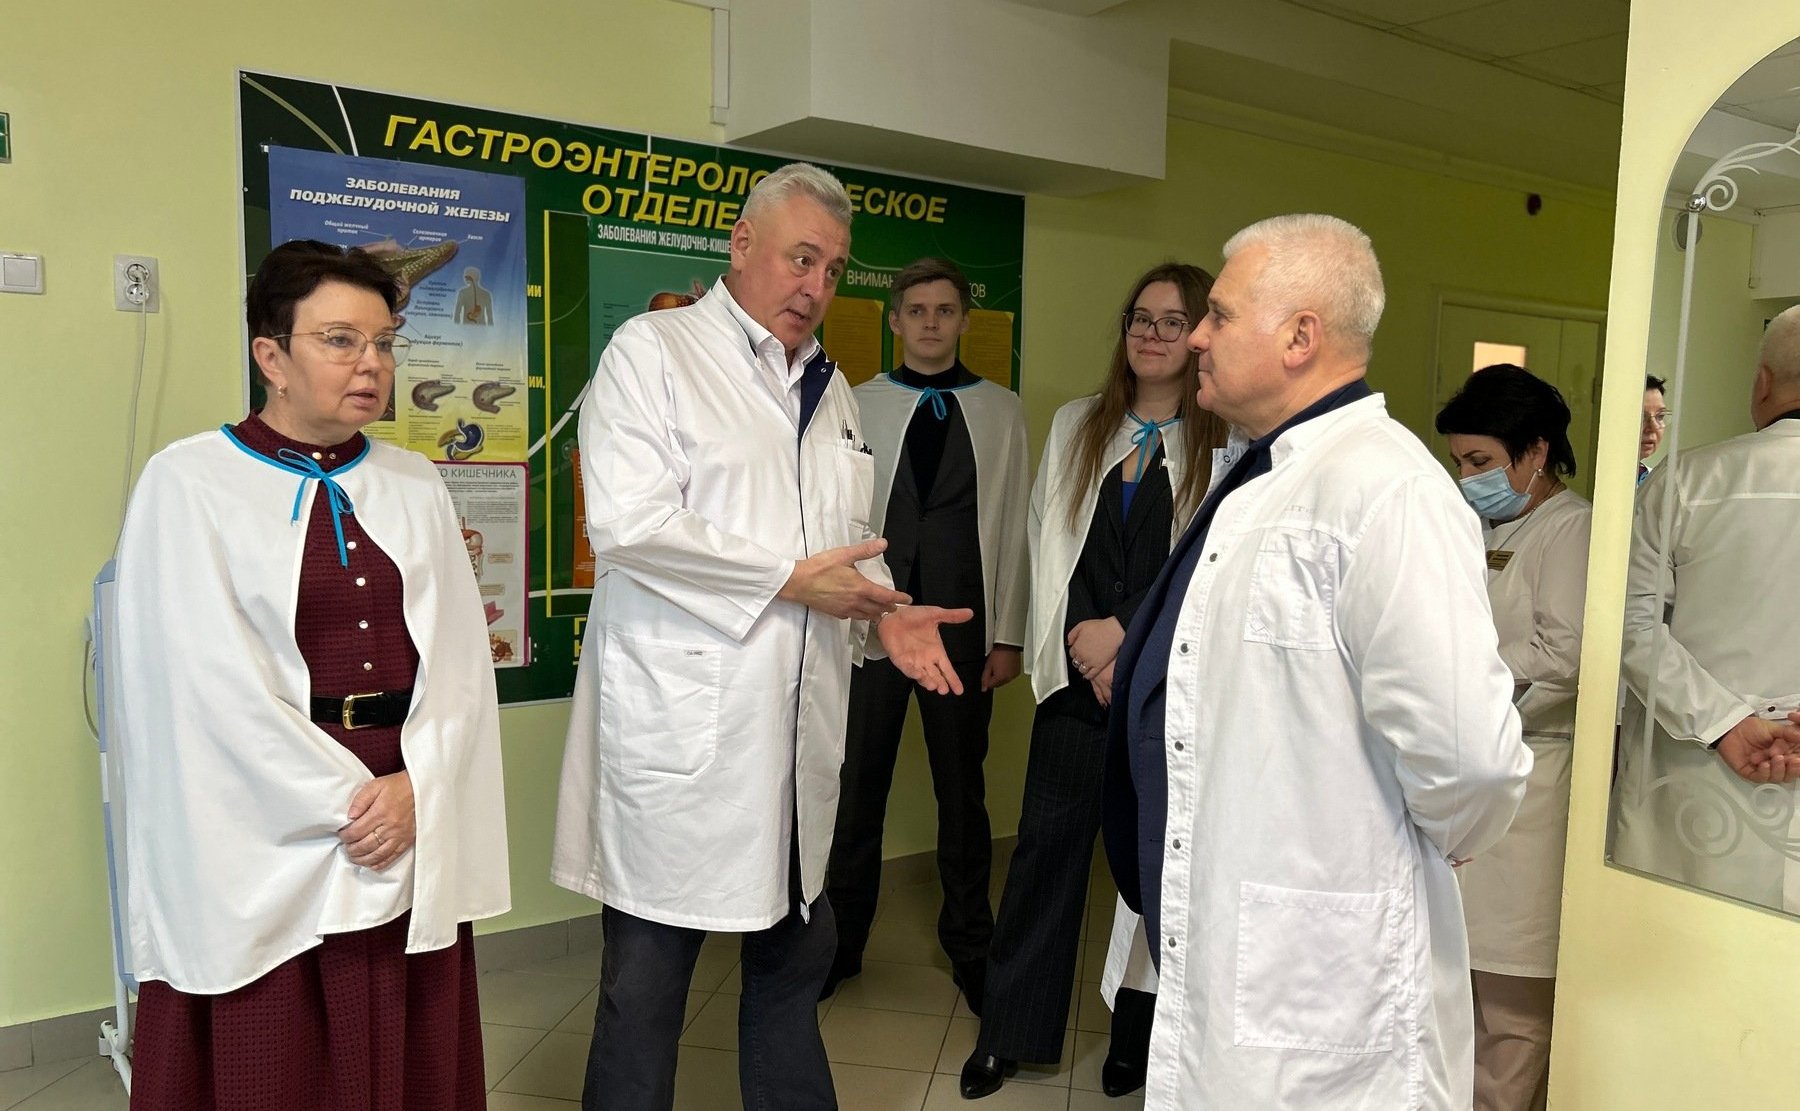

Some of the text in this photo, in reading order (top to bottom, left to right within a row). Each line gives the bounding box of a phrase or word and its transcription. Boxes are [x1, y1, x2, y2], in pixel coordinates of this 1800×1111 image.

[384, 115, 947, 223] ГАСТРОЭНТЕРОЛЕСКОЕ
[345, 177, 461, 200] ЗАБОЛЕВАНИЯ
[290, 188, 511, 222] ПОДЖЕЛУДОЧНОЙ ЖЕЛЕЗЫ
[582, 184, 741, 231] ОТДЕЛЕ
[597, 224, 731, 253] ЗАБОЛЕВАНИЯ ЖЕЛУДОЧНО-КИШЕ
[451, 468, 517, 479] КИШЕЧНИКА
